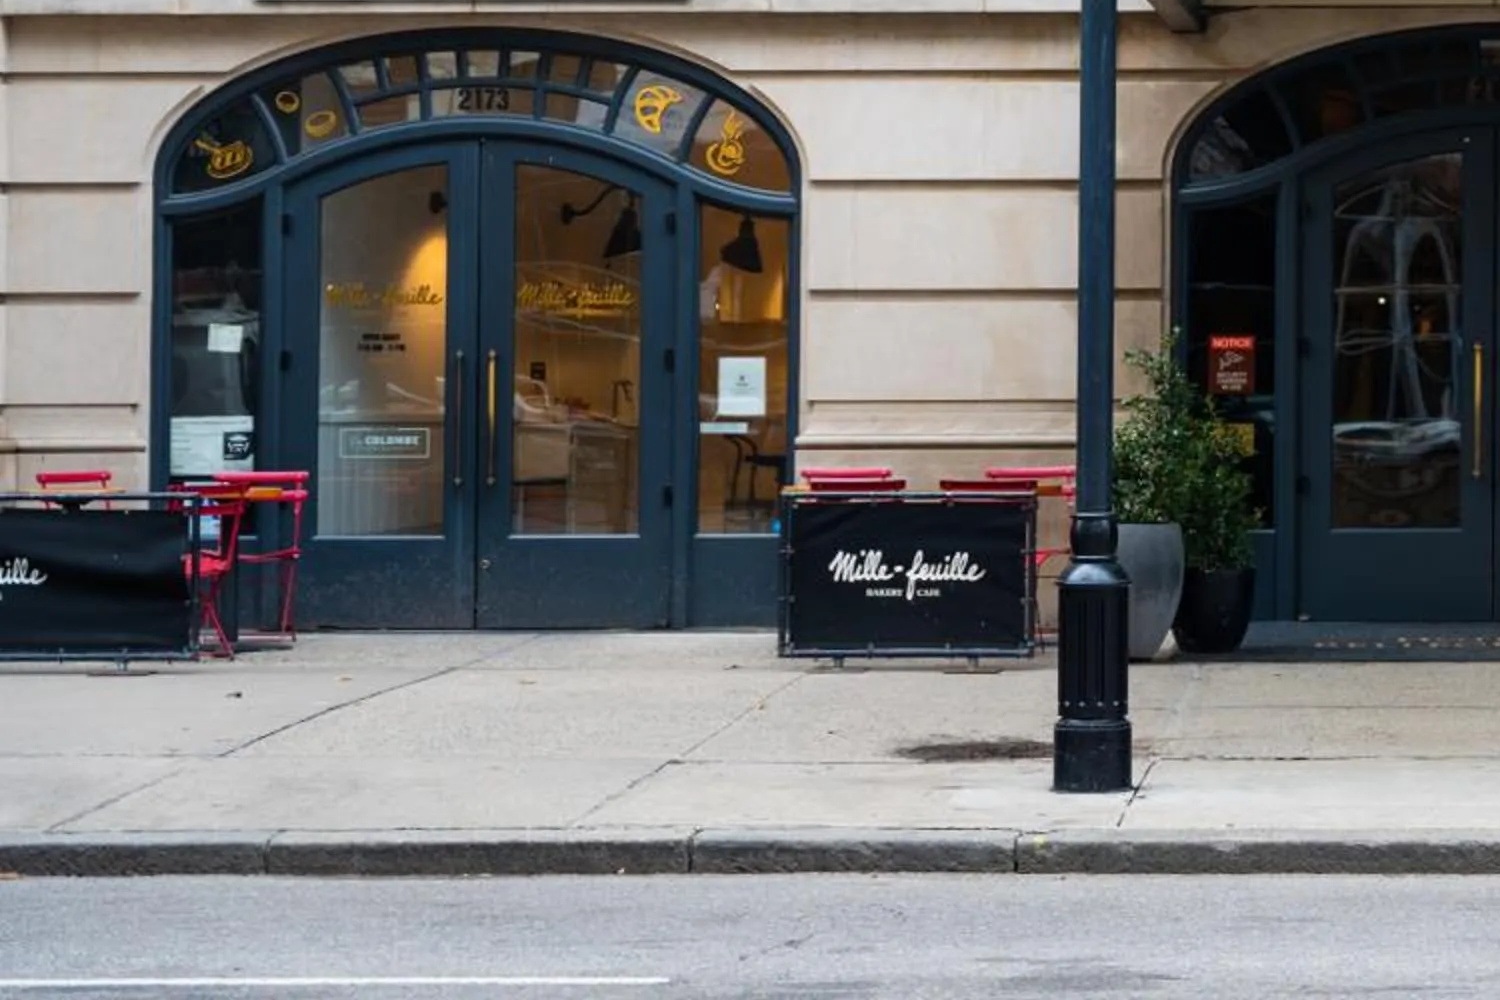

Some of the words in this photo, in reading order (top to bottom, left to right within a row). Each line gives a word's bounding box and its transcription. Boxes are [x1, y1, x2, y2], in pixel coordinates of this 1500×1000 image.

[457, 87, 511, 111] 2173
[1211, 337, 1253, 348] NOTICE
[866, 588, 904, 598] BAKERY
[916, 588, 941, 598] CAFE
